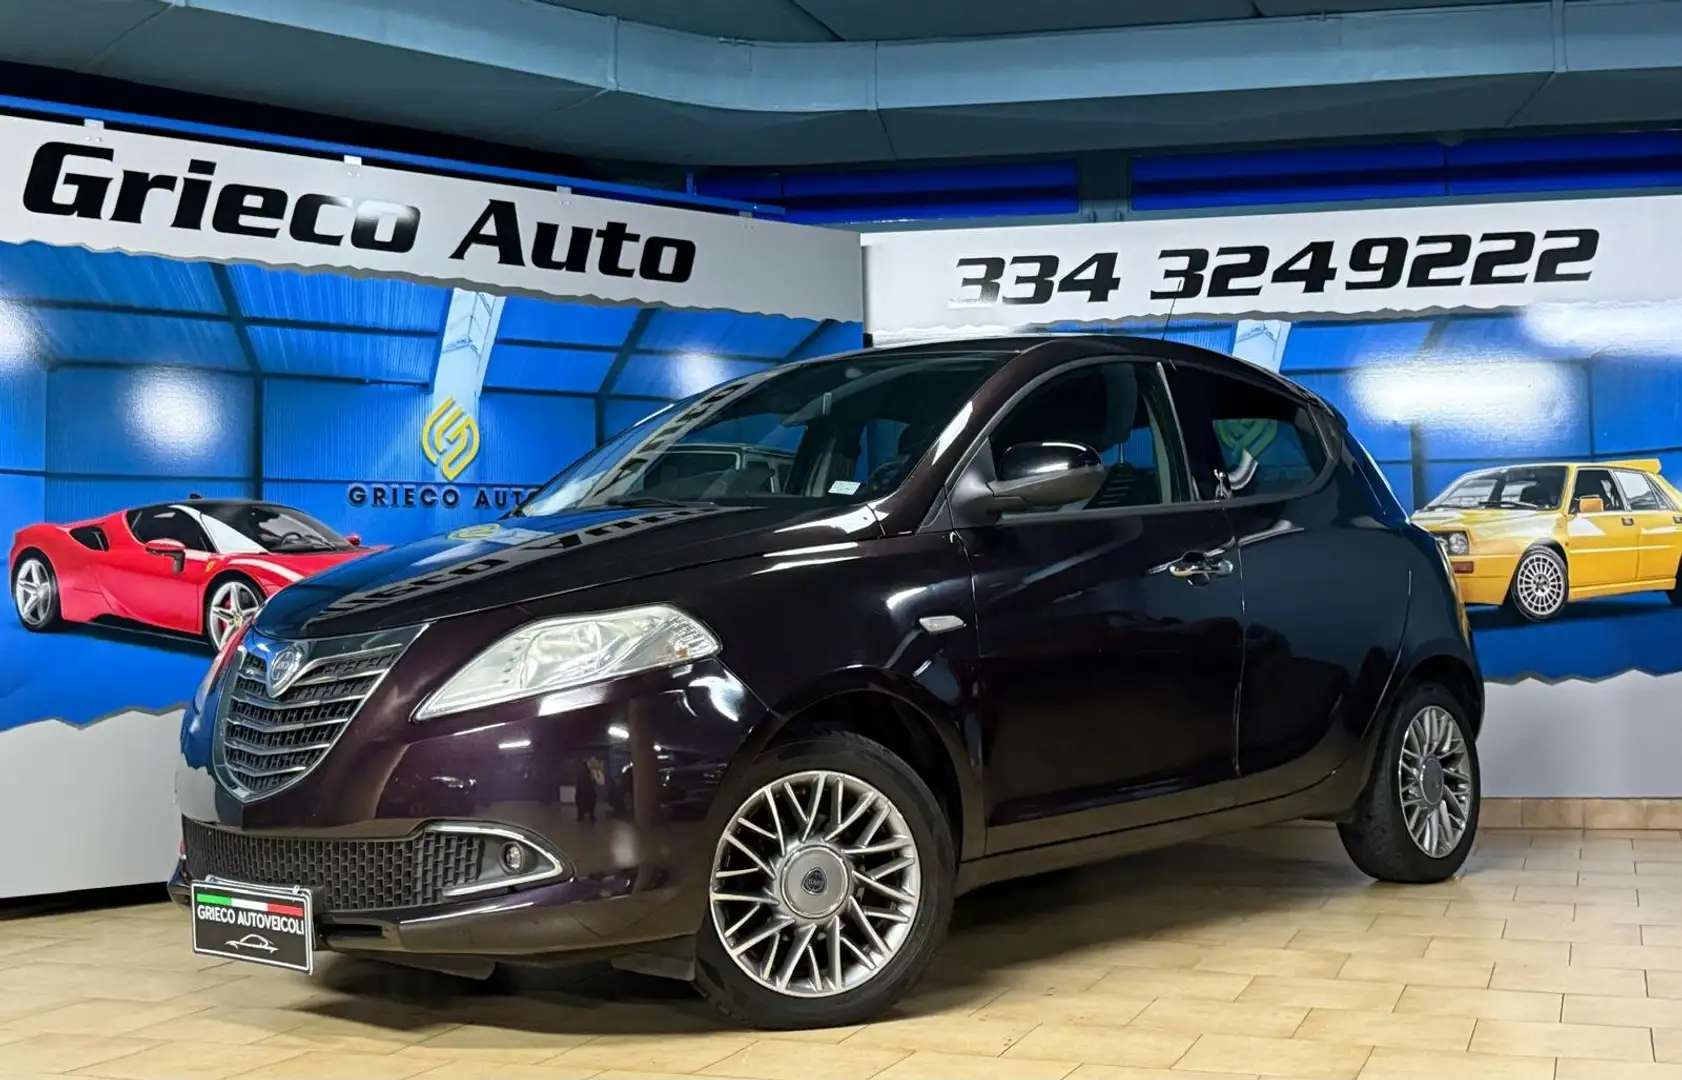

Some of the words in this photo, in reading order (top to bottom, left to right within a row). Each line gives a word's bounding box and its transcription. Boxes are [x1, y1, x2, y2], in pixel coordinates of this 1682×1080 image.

[23, 142, 420, 254] Grieco
[449, 199, 697, 284] Auto
[949, 252, 1121, 307] 334
[1151, 229, 1600, 301] 3249222
[349, 486, 460, 509] GRIECO
[474, 489, 538, 510] AUT
[197, 905, 236, 924] GRIECO
[237, 911, 305, 935] AUTOVEICOLI
